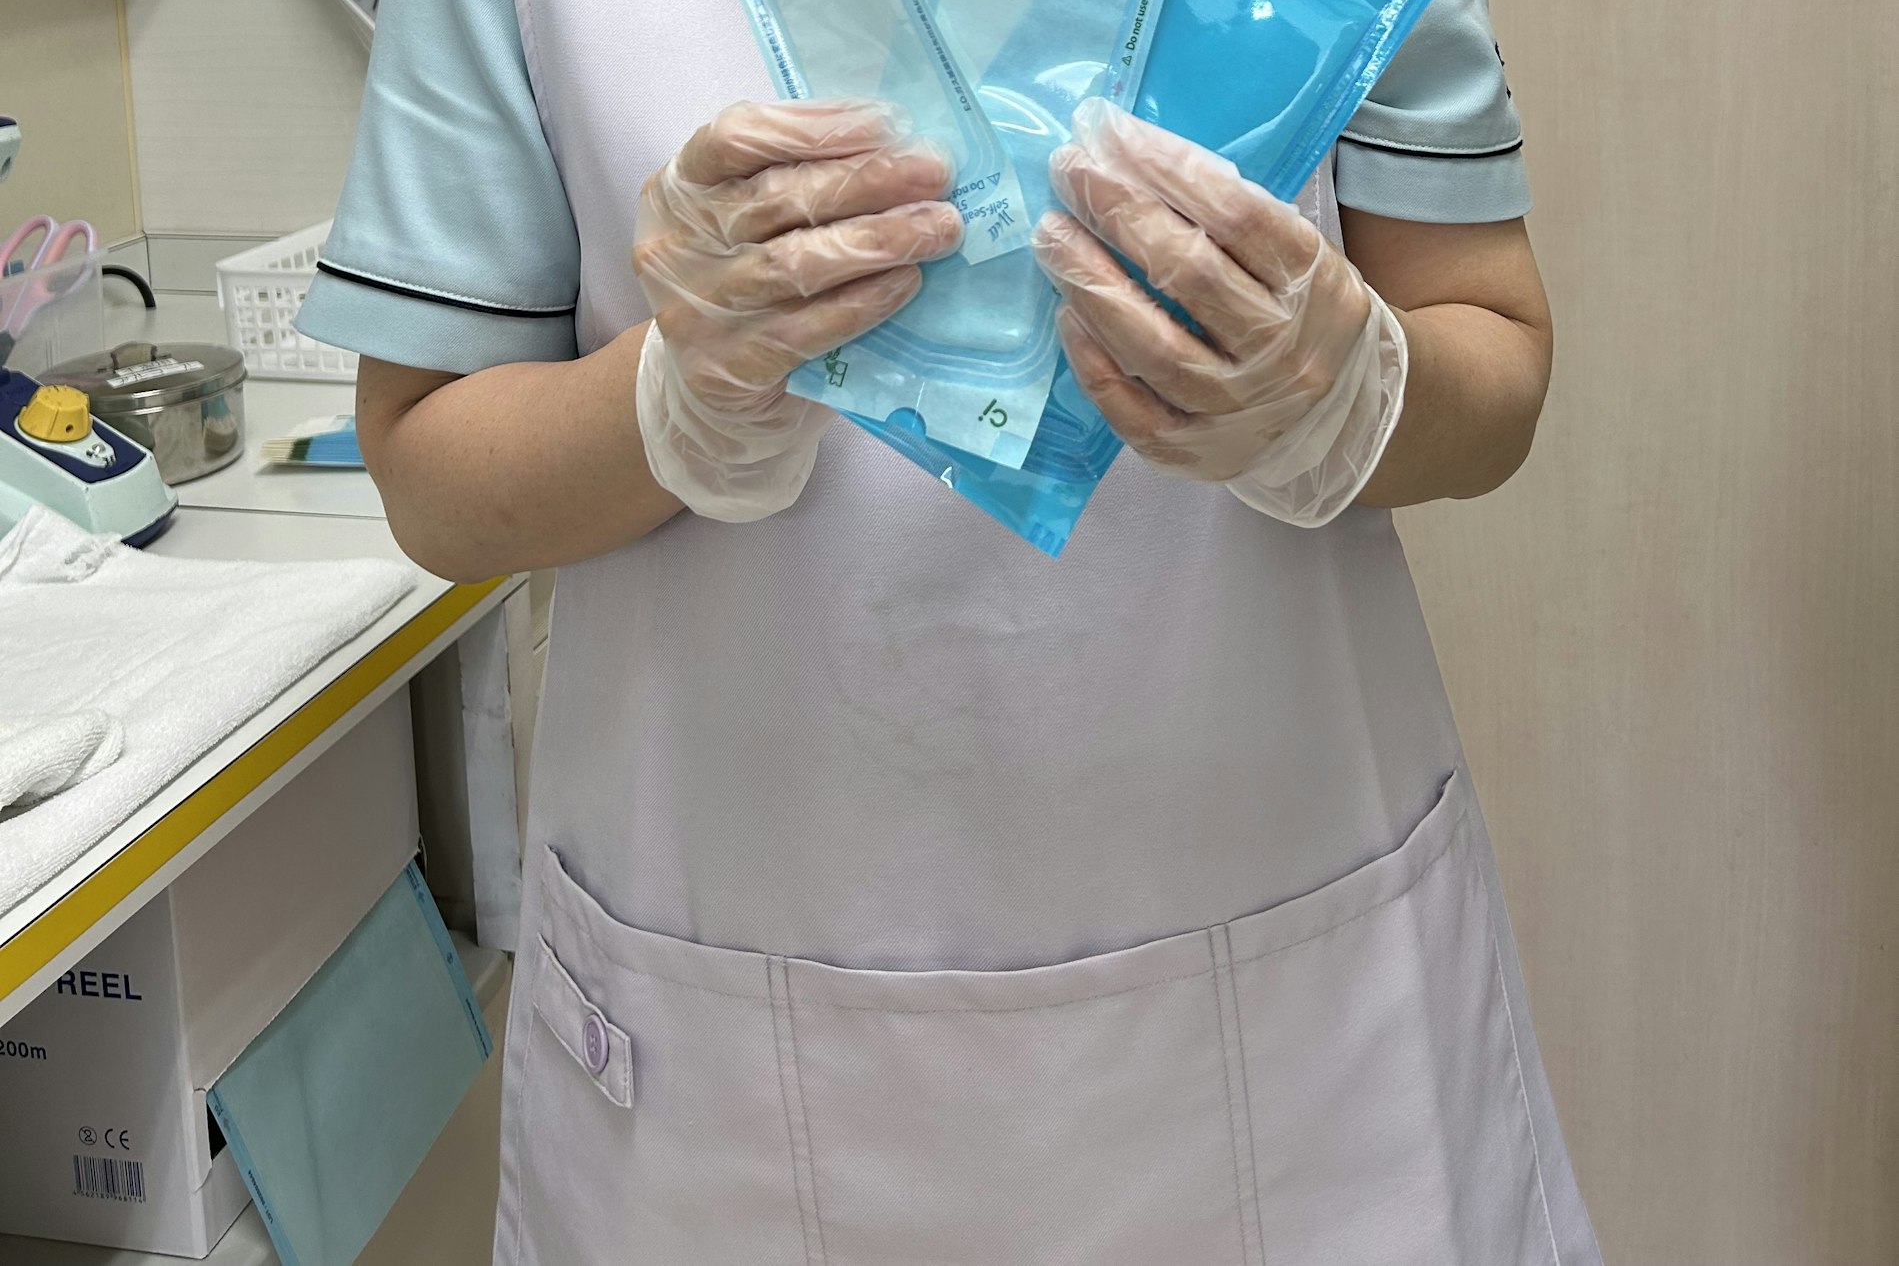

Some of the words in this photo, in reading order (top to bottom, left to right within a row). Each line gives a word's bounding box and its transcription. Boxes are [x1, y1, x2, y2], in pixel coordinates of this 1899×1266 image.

[1125, 35, 1137, 50] Do
[1132, 17, 1144, 36] not
[1138, 0, 1149, 17] use
[970, 179, 985, 190] Do
[57, 970, 142, 1001] REEL
